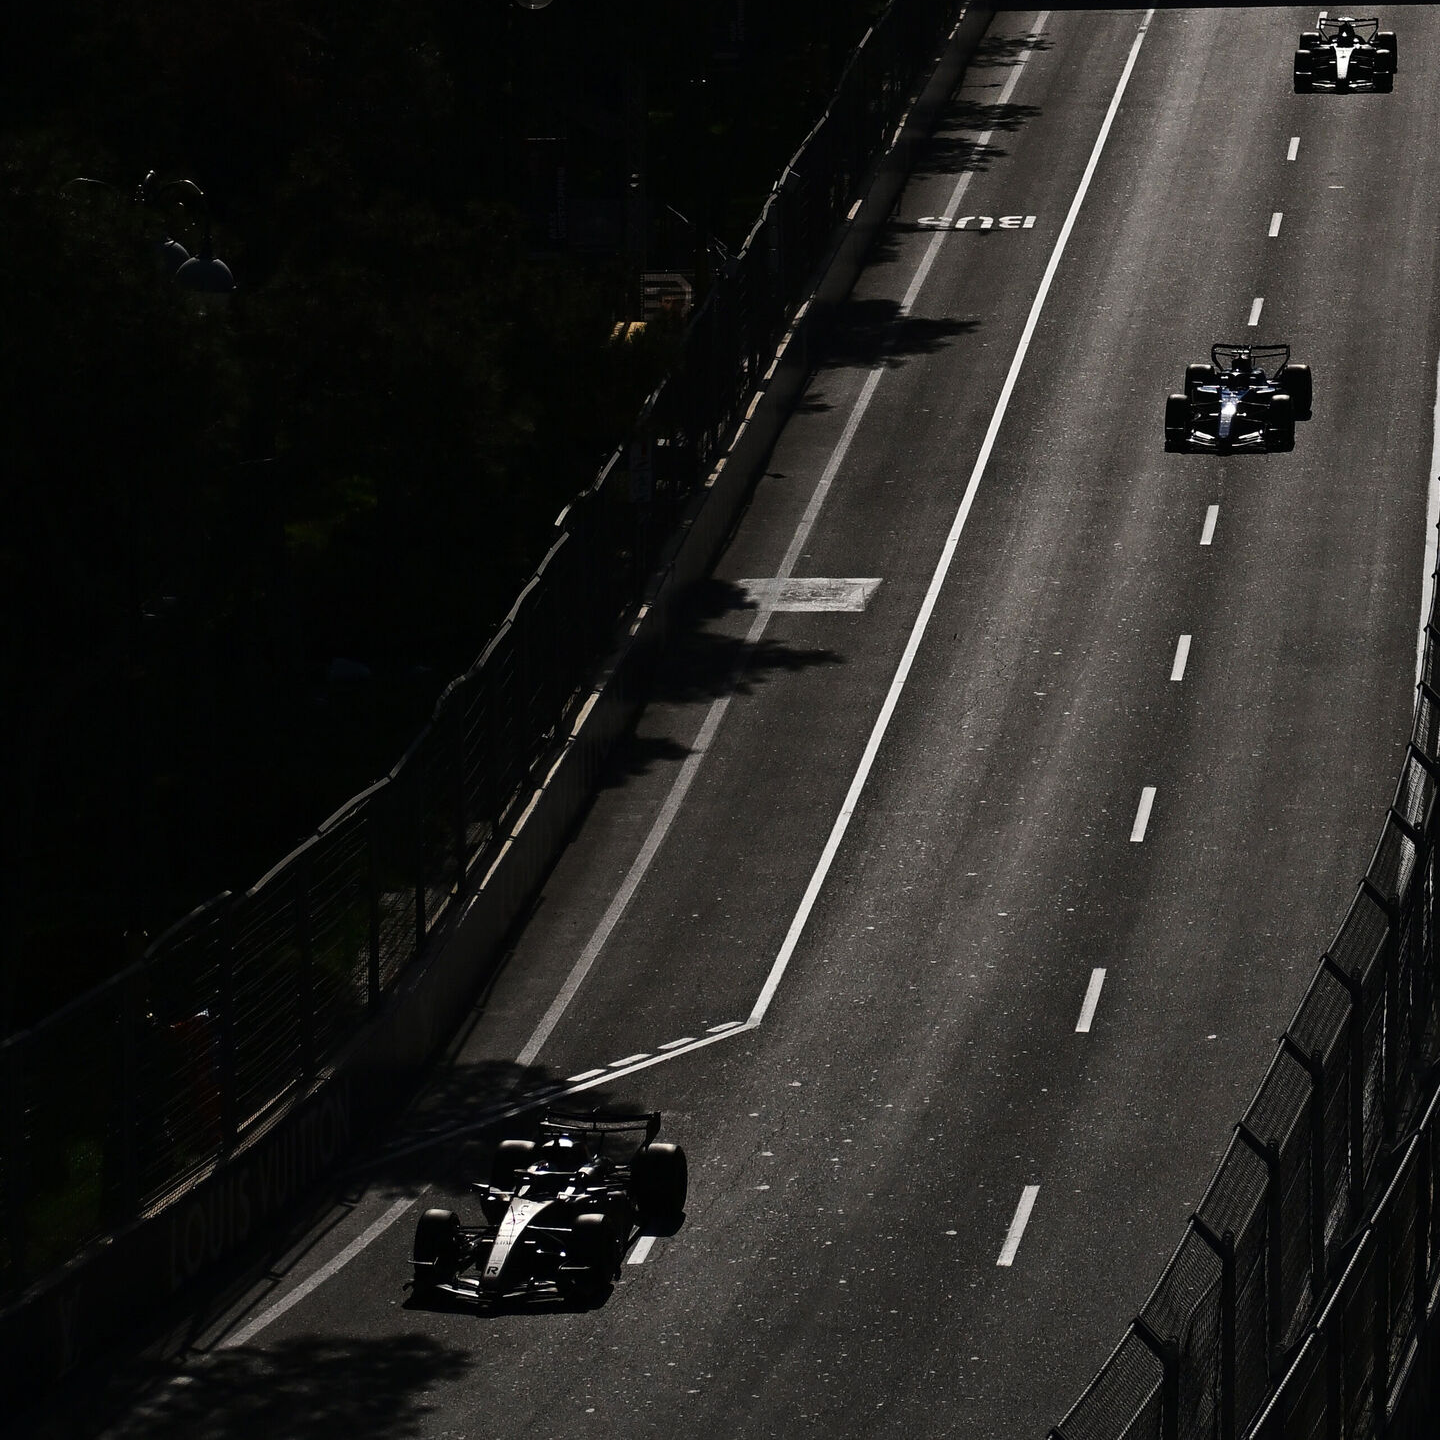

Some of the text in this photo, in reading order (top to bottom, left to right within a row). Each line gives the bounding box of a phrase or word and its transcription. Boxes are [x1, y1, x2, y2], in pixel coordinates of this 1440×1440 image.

[169, 1077, 350, 1292] LOUIS VUITTON
[487, 1266, 499, 1275] R
